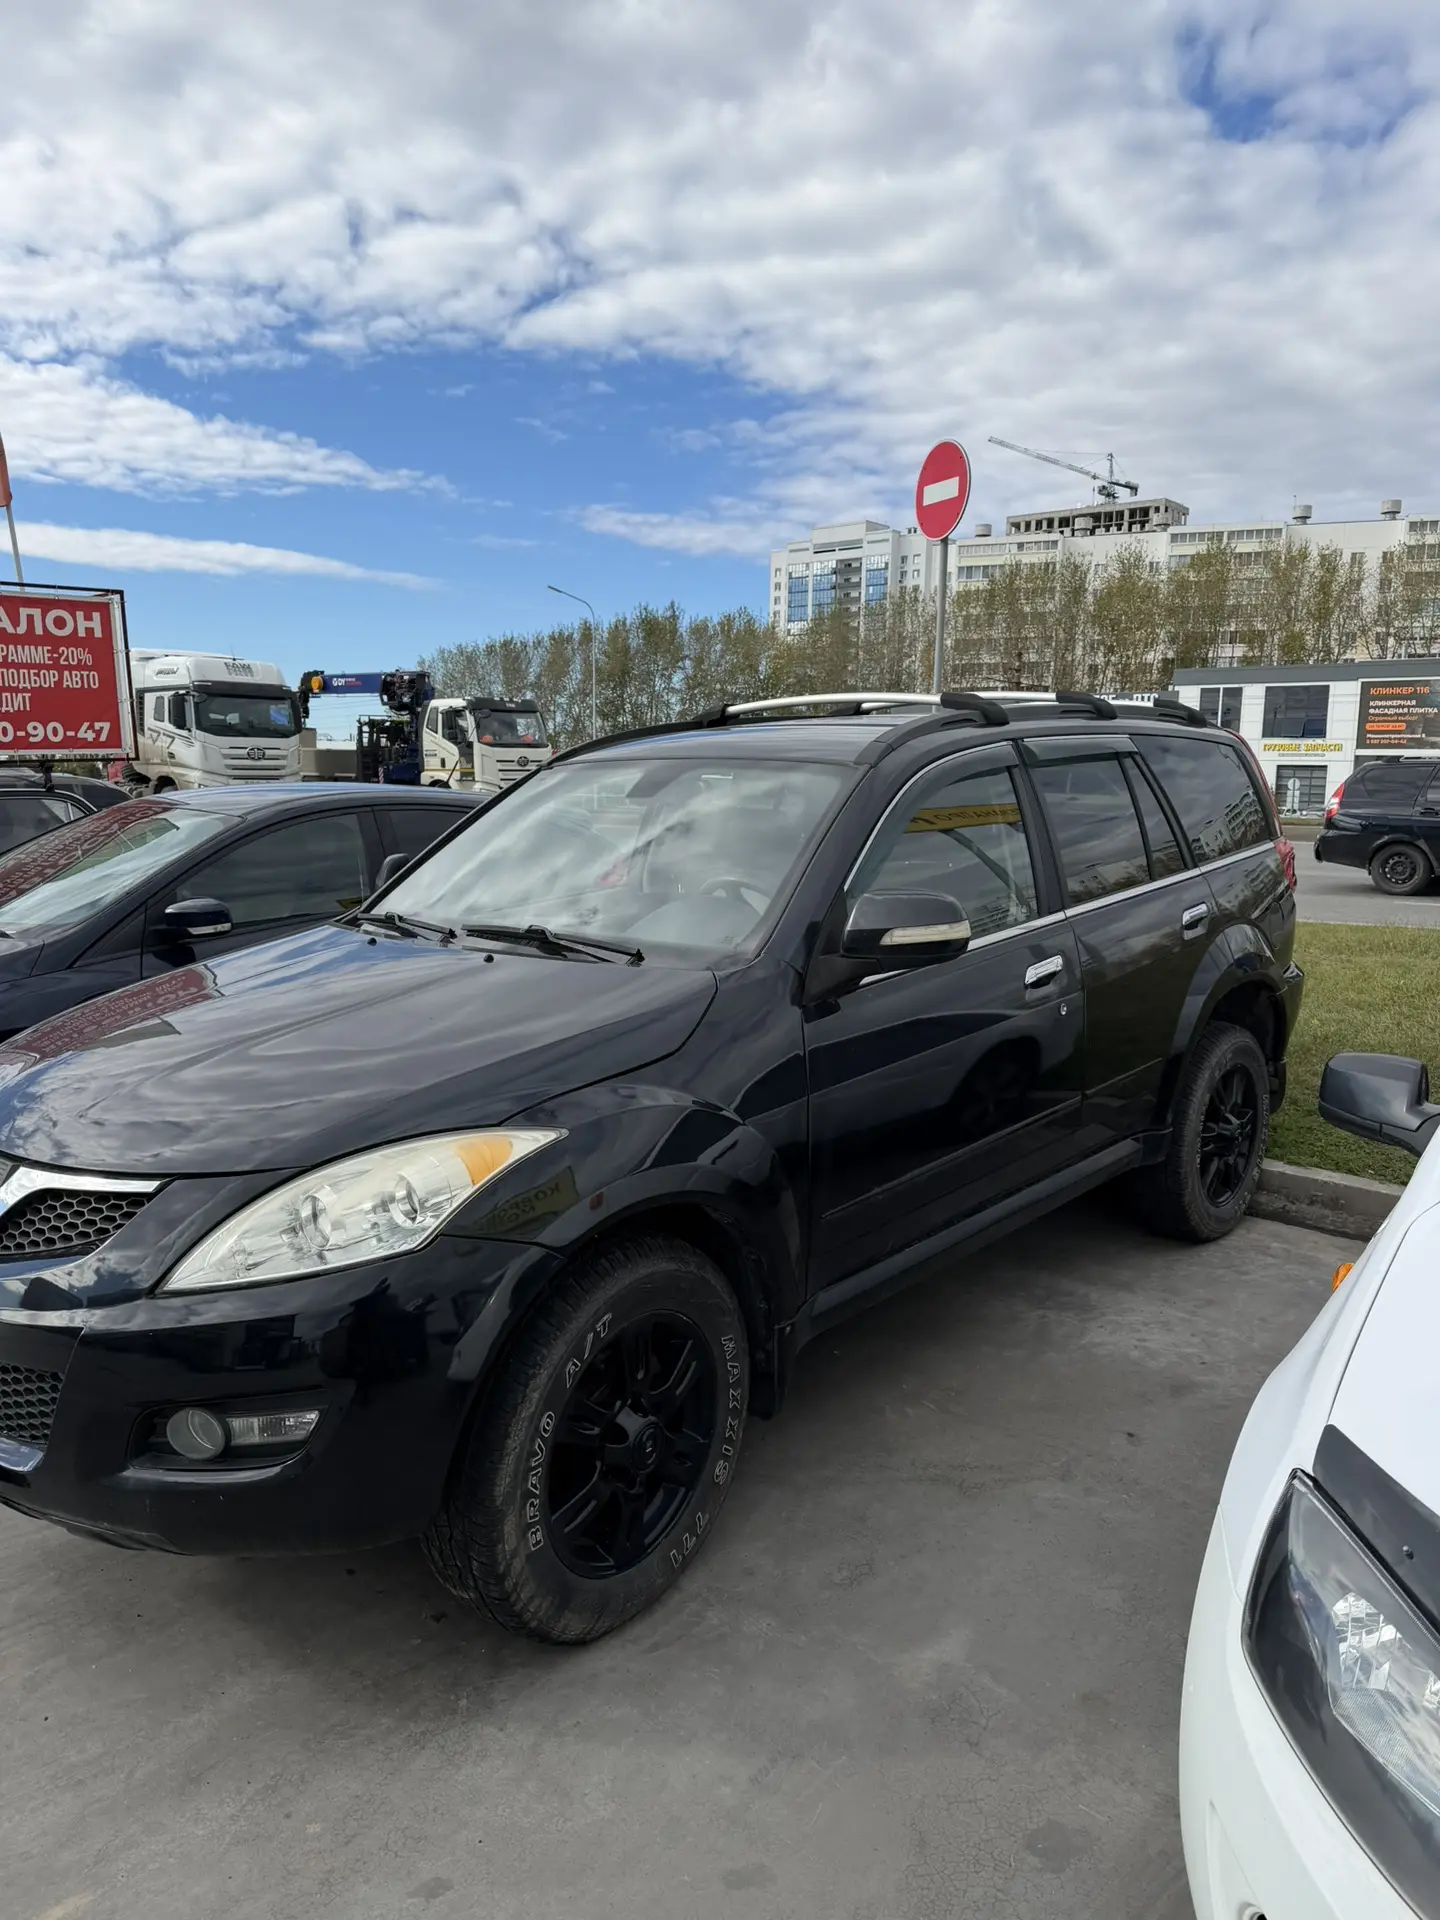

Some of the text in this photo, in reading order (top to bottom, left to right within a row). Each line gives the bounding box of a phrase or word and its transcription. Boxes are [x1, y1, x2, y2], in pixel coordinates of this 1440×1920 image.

[0, 668, 99, 690] ПОДБОР АВТО
[1370, 686, 1430, 695] КЛИНКЕР 116
[0, 692, 32, 713] ДИТ
[0, 721, 111, 743] 0-90-47
[1263, 743, 1343, 752] ГРУЗОВЫЕ ЗАПЧАСТИ
[714, 1334, 742, 1485] MAXXIS
[526, 1312, 612, 1551] BRAVO A/T
